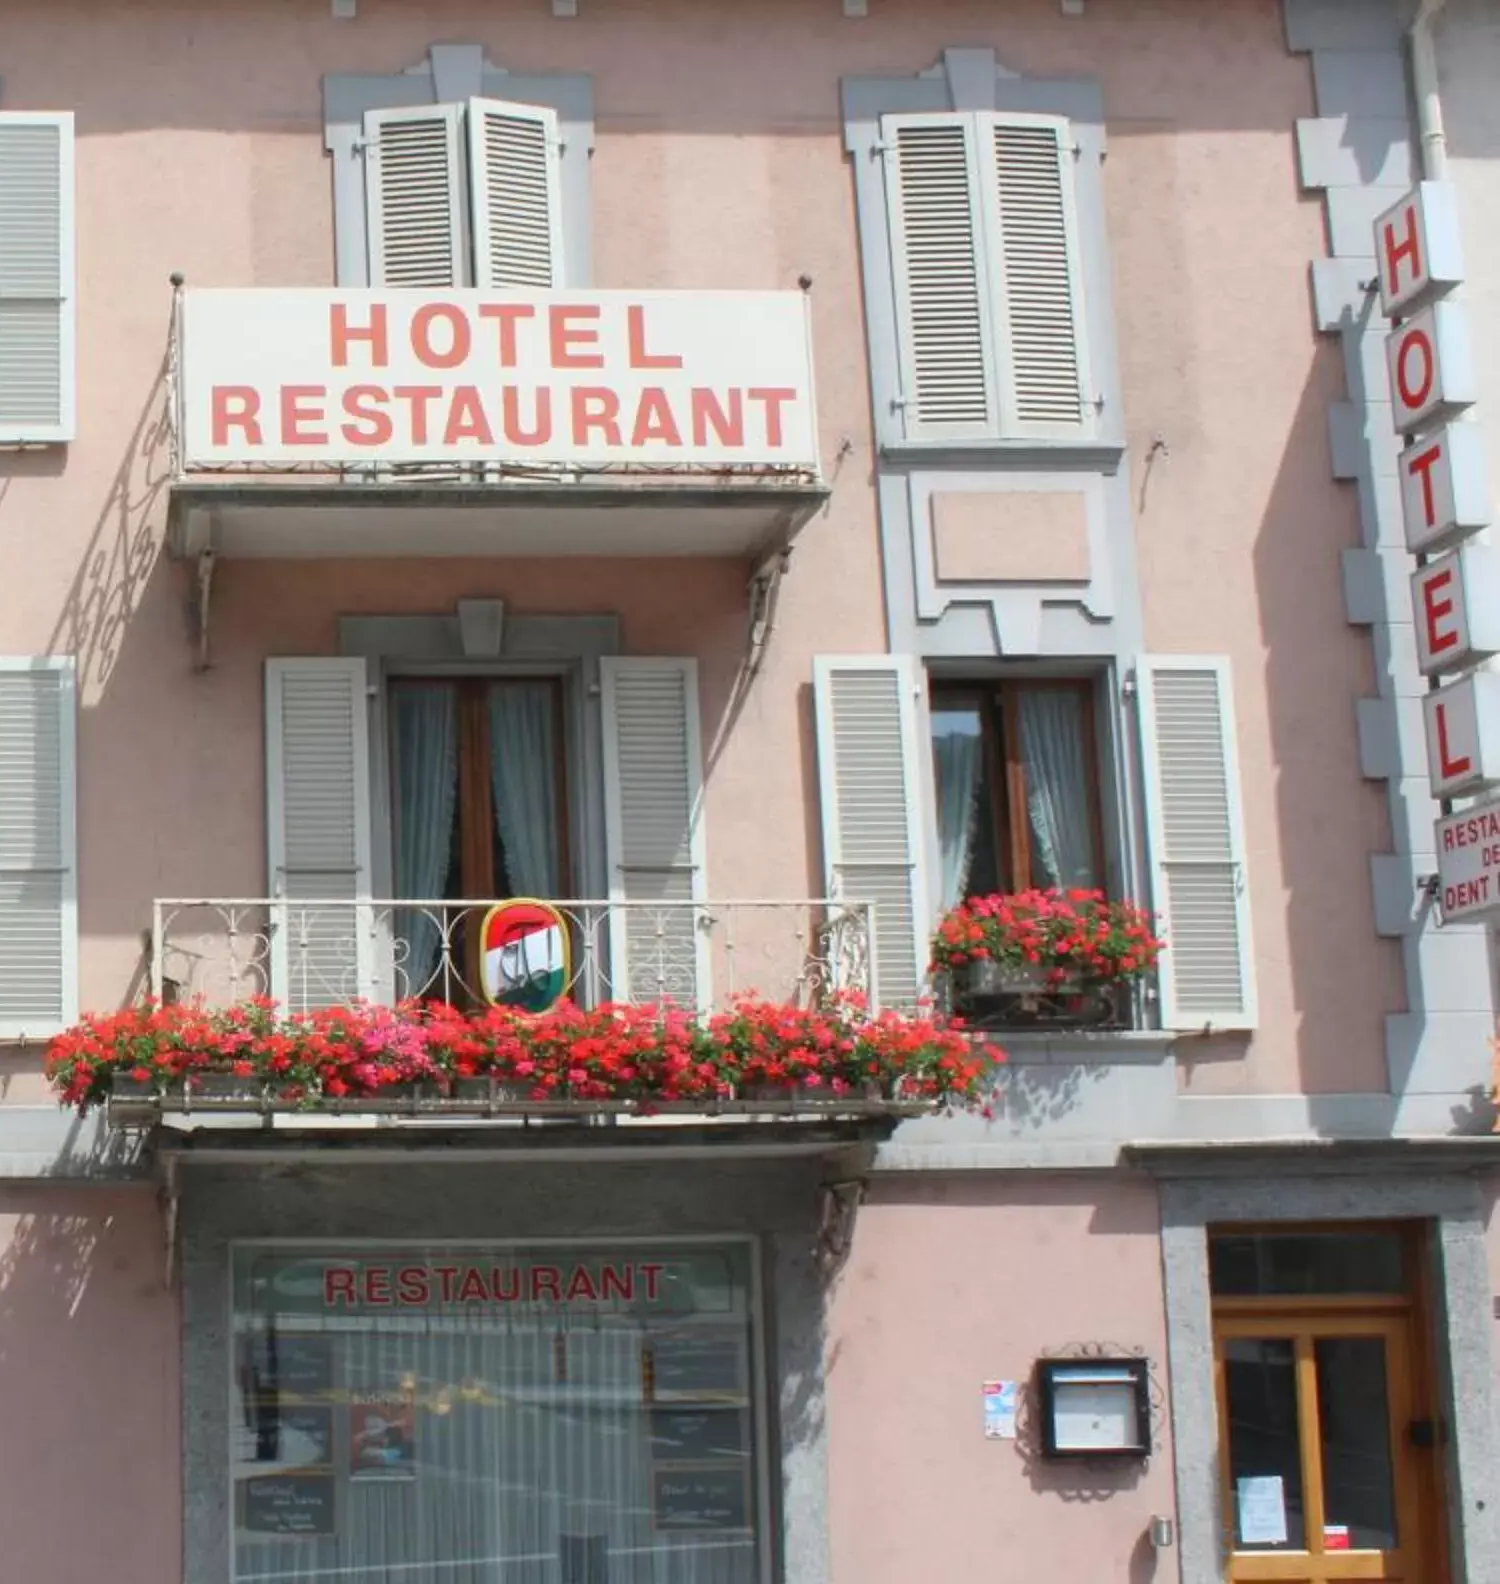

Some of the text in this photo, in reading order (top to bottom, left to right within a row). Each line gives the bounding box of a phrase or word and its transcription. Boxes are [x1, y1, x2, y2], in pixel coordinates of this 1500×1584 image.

[329, 302, 683, 369] HOTEL
[211, 384, 797, 448] RESTAURANT
[1384, 205, 1472, 779] HOTEL
[1445, 875, 1490, 911] DENT
[322, 1262, 667, 1306] RESTAURANT
